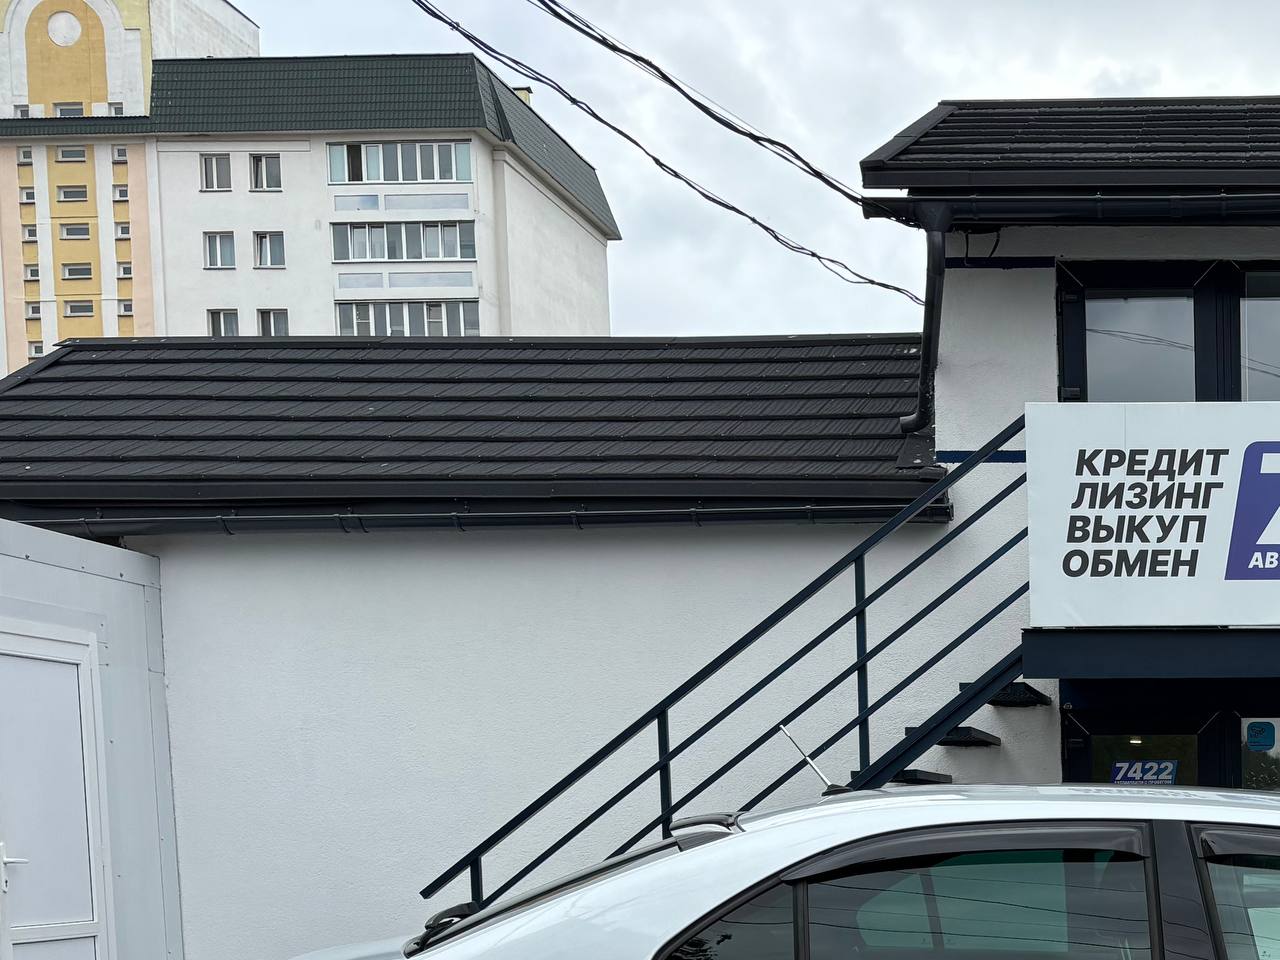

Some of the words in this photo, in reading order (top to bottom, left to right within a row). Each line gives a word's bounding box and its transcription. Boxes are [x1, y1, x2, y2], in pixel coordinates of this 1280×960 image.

[1075, 448, 1230, 482] КРЕДИТ
[1070, 481, 1224, 510] ЛИЗИНГ
[1066, 514, 1207, 544] ВЫКУП
[1062, 549, 1199, 578] ОБМЕН
[1115, 761, 1174, 781] 7422
